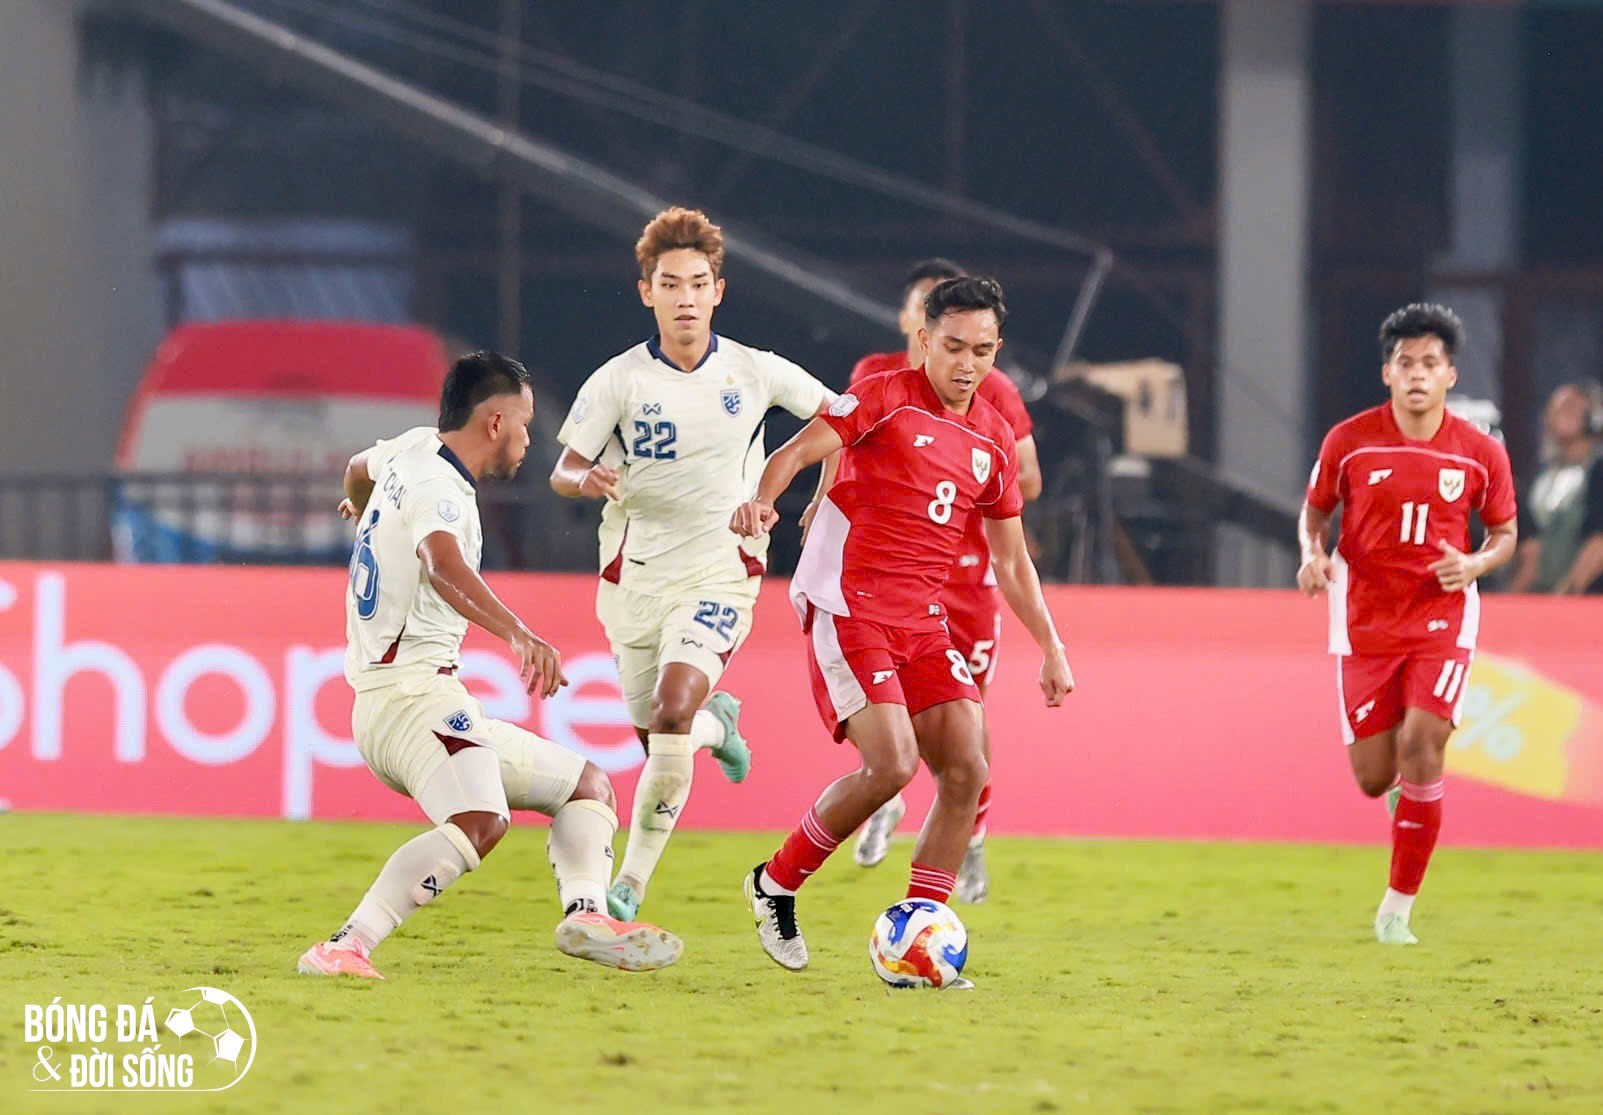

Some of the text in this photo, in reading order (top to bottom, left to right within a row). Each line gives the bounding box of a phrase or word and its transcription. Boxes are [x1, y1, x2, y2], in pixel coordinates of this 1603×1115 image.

[633, 420, 677, 460] 22
[927, 480, 957, 525] 8
[1400, 501, 1430, 545] 11
[693, 600, 740, 642] 22
[945, 648, 975, 686] 8
[967, 640, 995, 675] 5
[0, 570, 647, 821] hope
[1433, 659, 1464, 703] 11
